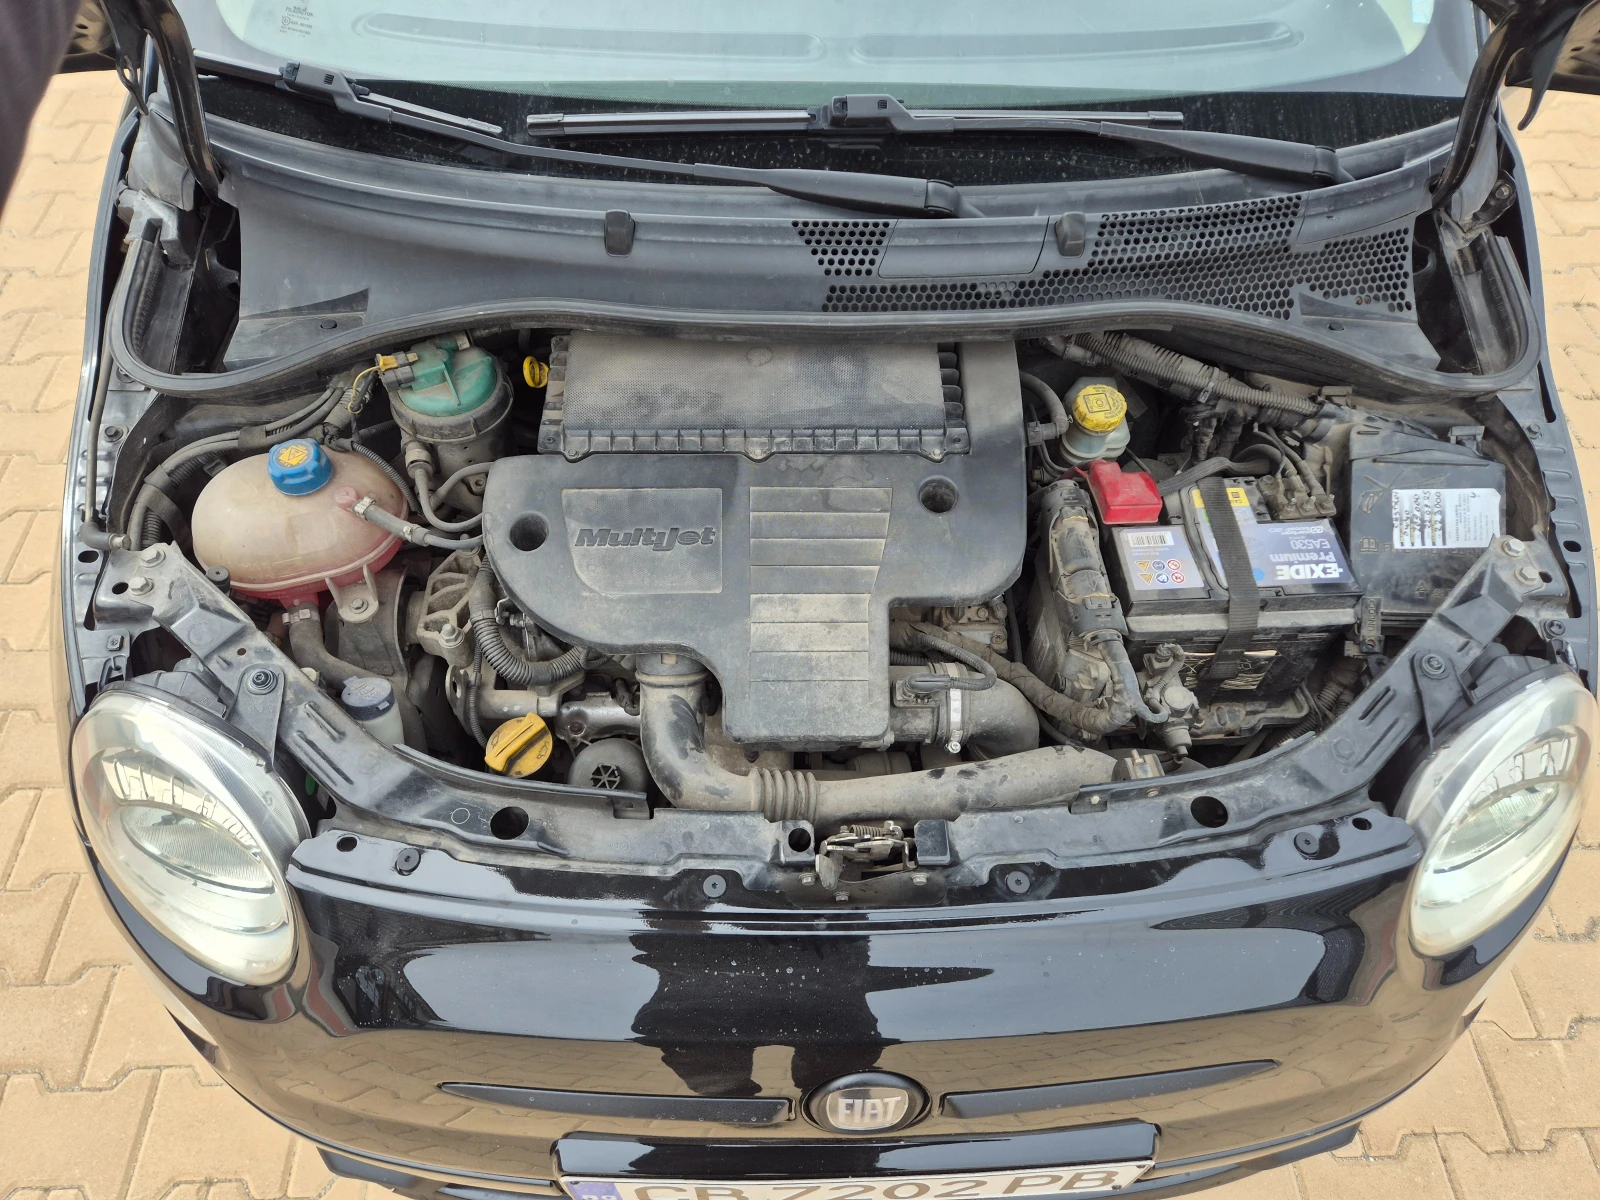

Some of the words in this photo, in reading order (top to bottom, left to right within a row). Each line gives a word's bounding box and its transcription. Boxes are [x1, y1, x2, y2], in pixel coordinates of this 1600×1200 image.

[285, 6, 313, 17] PILKINGTON
[1289, 538, 1332, 550] EA530
[1268, 551, 1337, 564] Premium
[1274, 562, 1344, 581] EXIDE
[838, 1096, 902, 1123] FIAT
[772, 1179, 988, 1200] 7202
[1002, 1170, 1120, 1195] PB
